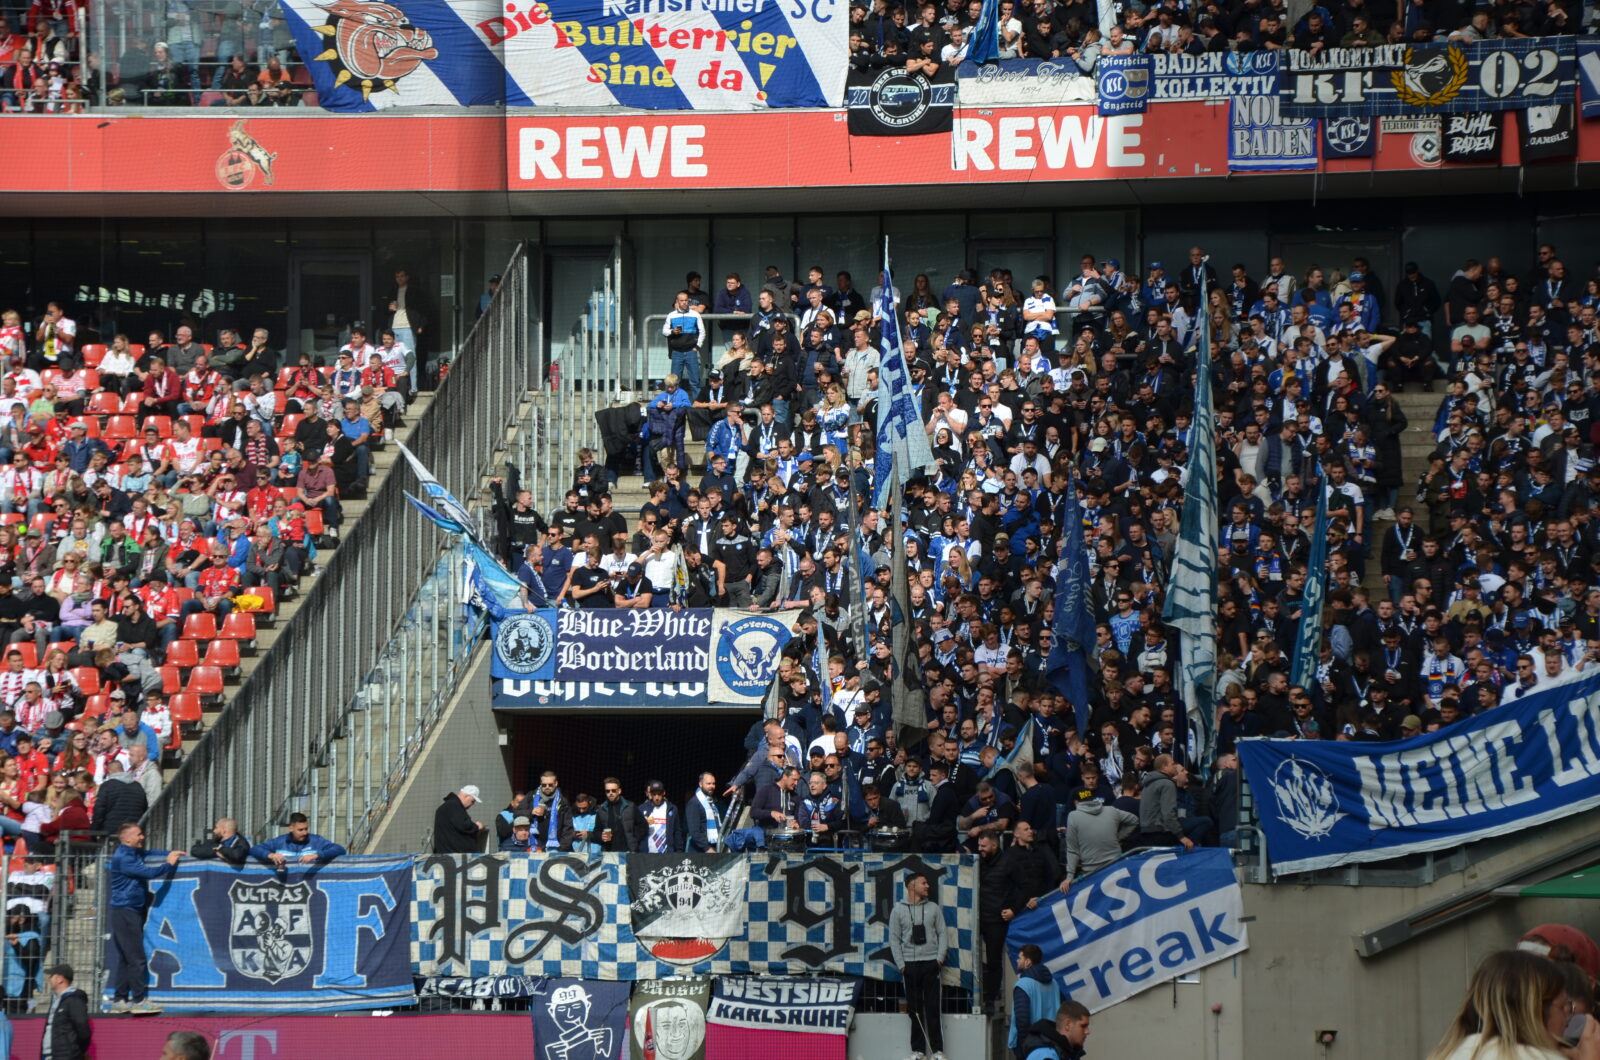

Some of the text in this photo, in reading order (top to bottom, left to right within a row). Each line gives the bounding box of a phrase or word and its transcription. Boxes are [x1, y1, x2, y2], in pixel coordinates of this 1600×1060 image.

[476, 2, 552, 47] Die
[554, 18, 797, 60] Bullterrier
[586, 52, 676, 88] sind
[976, 61, 1080, 87] Blood Type
[1101, 56, 1149, 68] Pforzheim
[1153, 51, 1223, 75] BADEN
[1480, 50, 1560, 98] 02
[850, 86, 950, 105] 20 13
[1106, 76, 1123, 94] KSC
[1154, 75, 1276, 98] KOLLEKTIV
[873, 104, 927, 125] KARLSRUHE
[1233, 95, 1313, 127] NO
[519, 125, 708, 180] REWE
[951, 114, 1145, 171] REWE
[1233, 128, 1313, 158] BADEN
[1447, 132, 1496, 156] BADEN
[557, 608, 711, 641] Blue-White
[557, 641, 709, 673] Borderland
[1353, 690, 1600, 831] MEINE LI
[236, 886, 304, 903] ULTRAS
[1051, 853, 1189, 944] KSC
[312, 874, 397, 989] F
[1053, 907, 1240, 1001] Freak
[418, 976, 495, 997] ACAB
[558, 988, 578, 1000] 99
[722, 977, 856, 1004] WESTSIDE
[715, 1002, 850, 1028] KARLSRUHE
